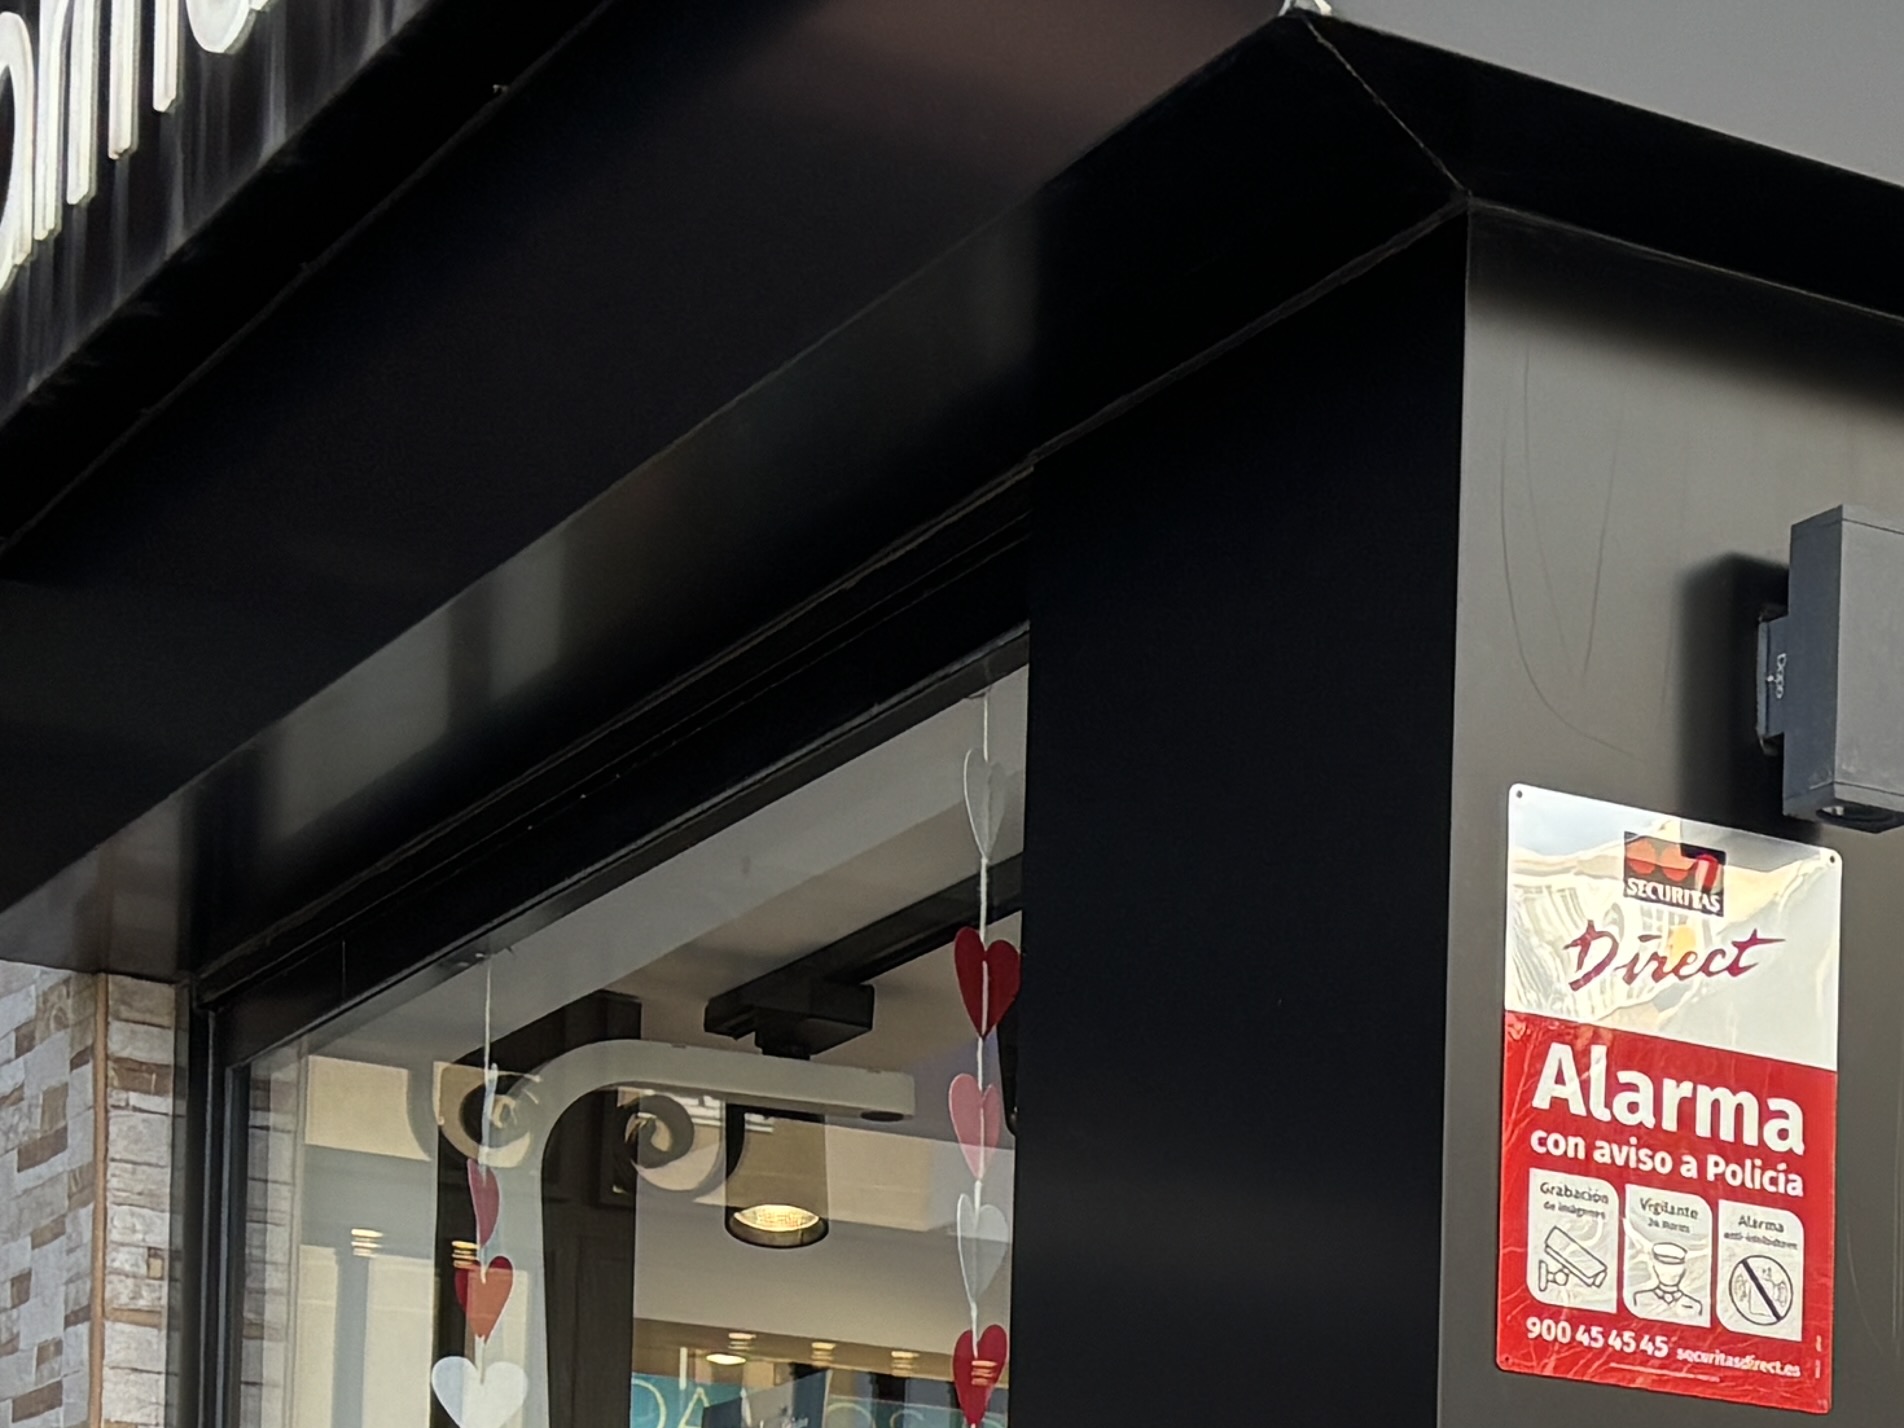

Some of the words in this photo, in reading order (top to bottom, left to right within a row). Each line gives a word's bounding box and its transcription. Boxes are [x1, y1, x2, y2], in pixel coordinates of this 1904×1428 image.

[1626, 877, 1721, 914] SECURITAS
[1563, 919, 1786, 991] Direct
[1531, 1041, 1805, 1155] Alarma
[1531, 1131, 1586, 1161] con
[1594, 1137, 1671, 1176] aviso
[1680, 1155, 1698, 1179] a
[1706, 1153, 1804, 1197] Policía
[1540, 1181, 1609, 1204] Grabación
[1640, 1198, 1698, 1220] Vigilante
[1526, 1316, 1570, 1344] 900
[1575, 1325, 1604, 1348] 45
[1608, 1329, 1636, 1352] 45
[1640, 1334, 1669, 1358] 45
